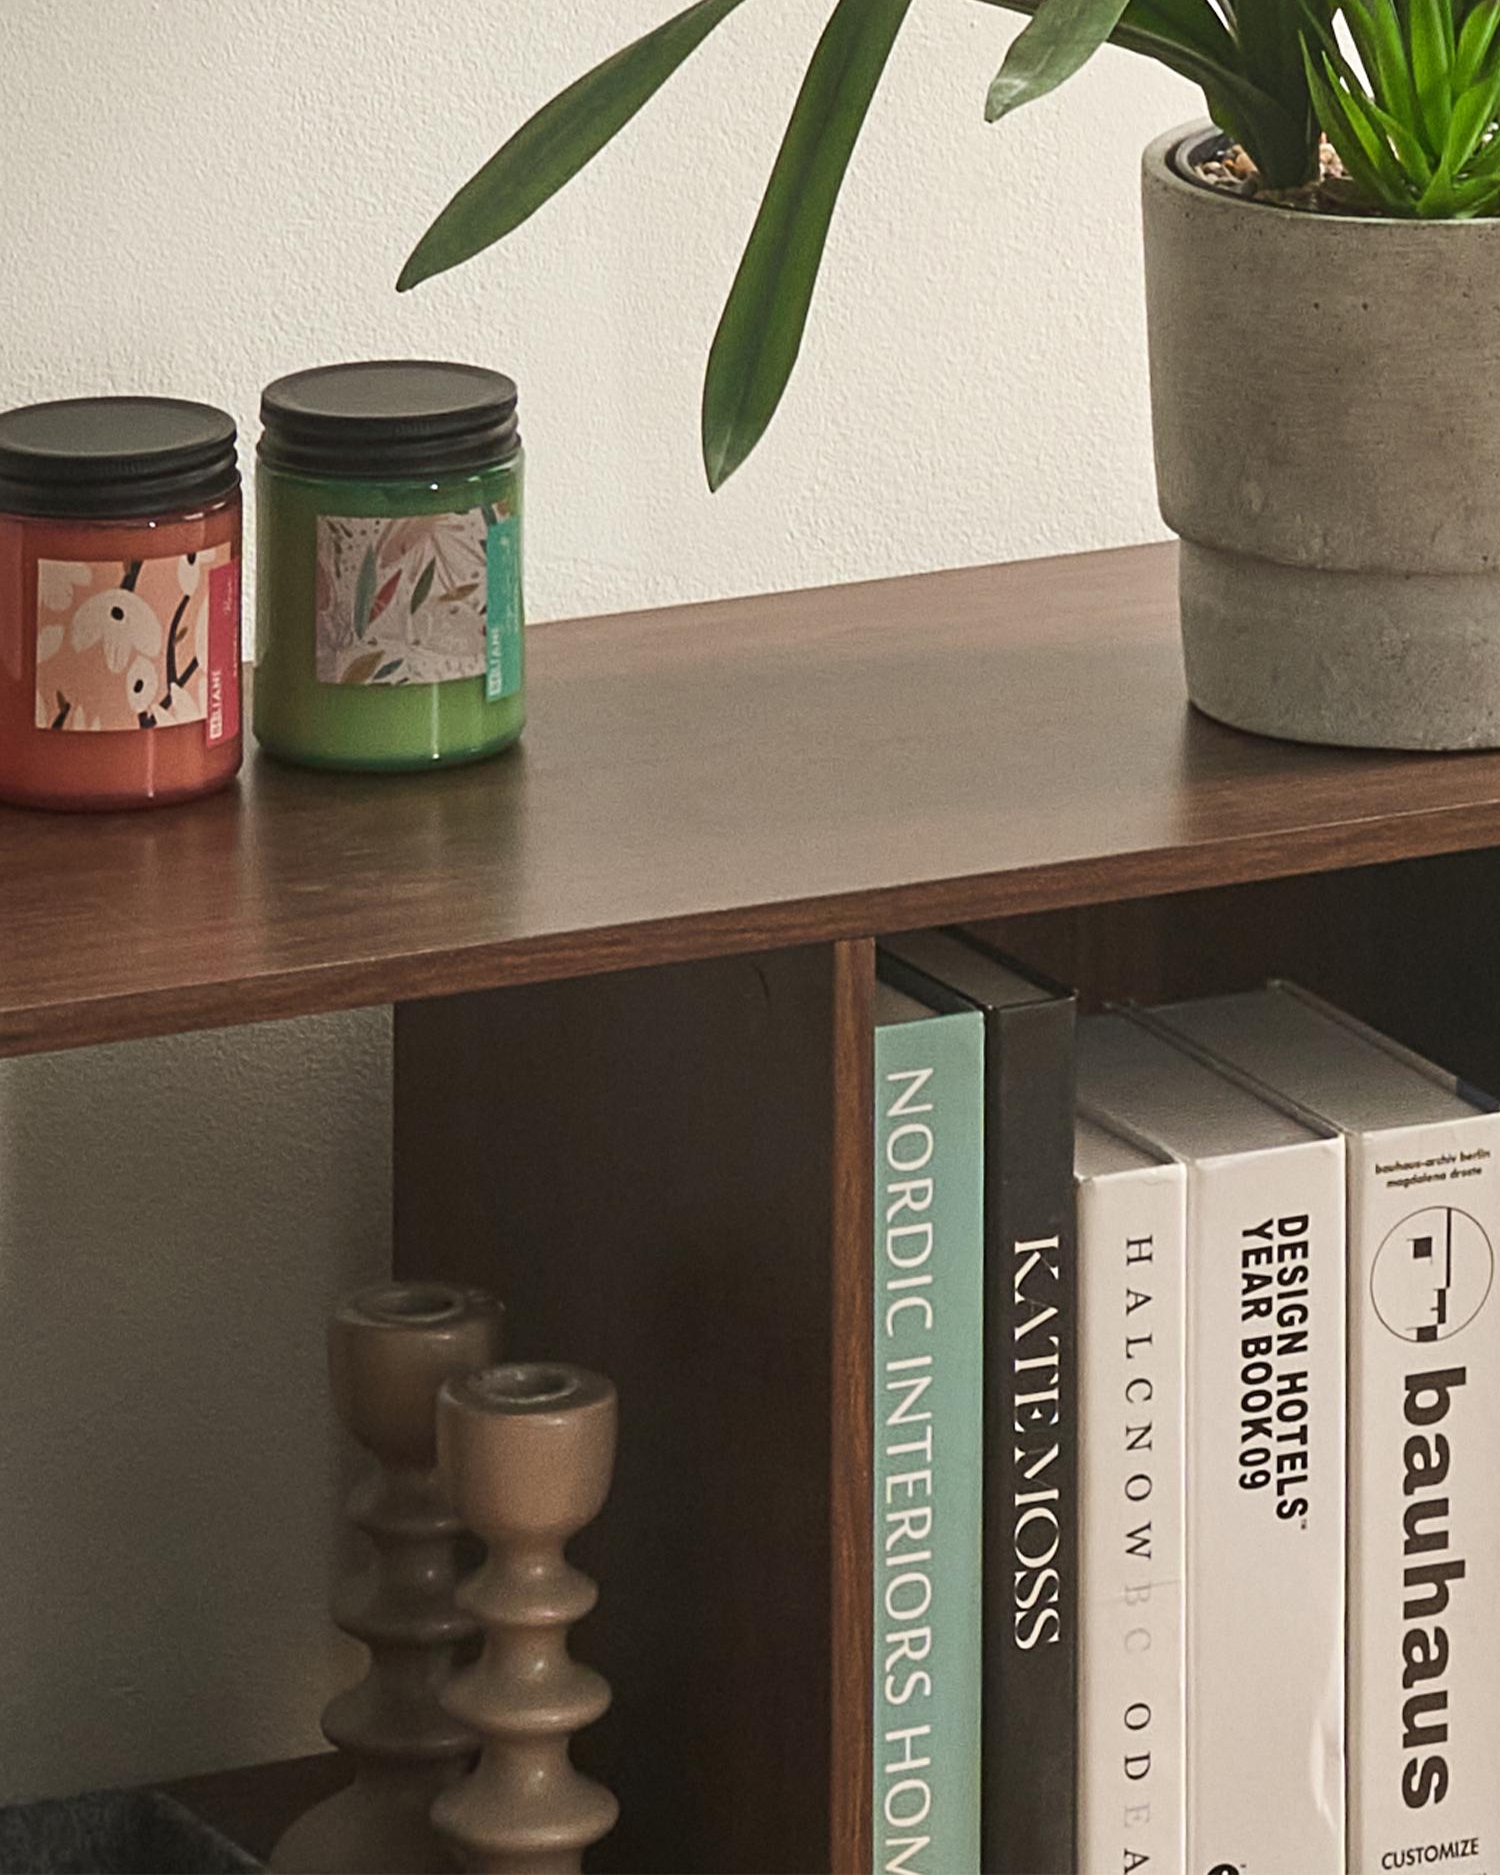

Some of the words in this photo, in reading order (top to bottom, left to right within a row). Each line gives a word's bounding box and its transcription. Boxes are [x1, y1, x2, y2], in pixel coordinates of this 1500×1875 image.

[886, 1068, 933, 1337] NORDIC
[1242, 1218, 1273, 1322] YEAR
[1277, 1214, 1309, 1356] DESIGN
[1014, 1234, 1059, 1432] KATE
[885, 1355, 932, 1705] INTERIORS
[1014, 1443, 1060, 1650] MOSS
[1401, 1366, 1467, 1809] bauhaus
[1382, 1837, 1479, 1870] CUSTOMIZE
